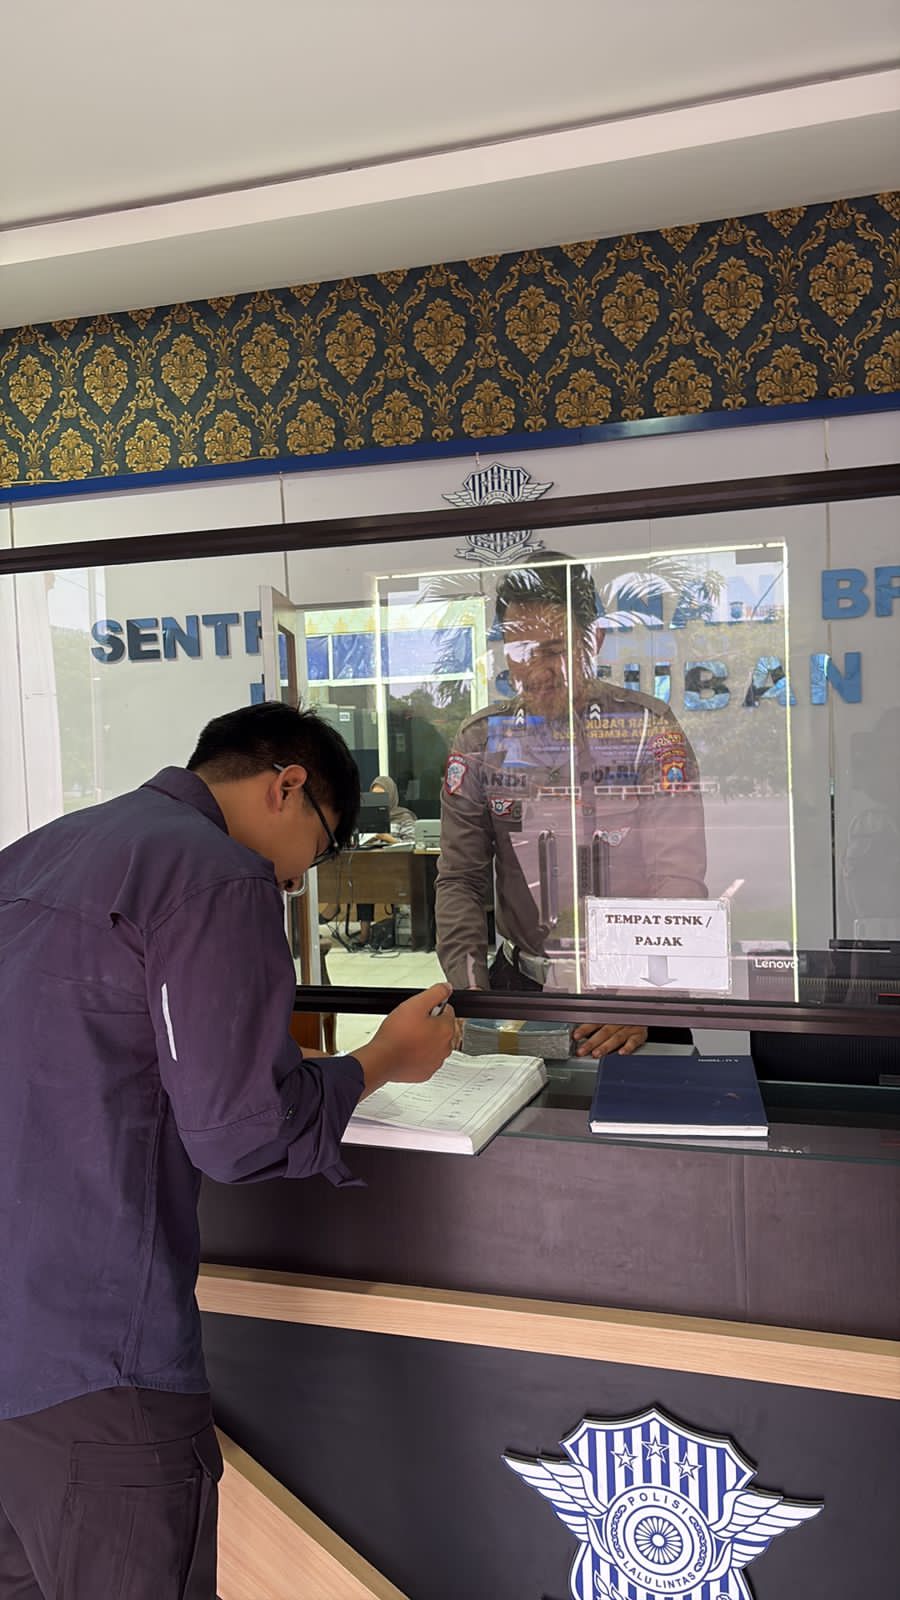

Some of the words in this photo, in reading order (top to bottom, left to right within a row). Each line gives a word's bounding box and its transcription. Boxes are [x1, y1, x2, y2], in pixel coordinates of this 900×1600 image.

[597, 652, 862, 711] UBAN
[605, 914, 661, 925] TEMPAT
[664, 915, 703, 926] STNK
[635, 936, 683, 947] PAJAK
[627, 1491, 688, 1516] POLISI
[623, 1560, 652, 1585] LALU
[655, 1571, 696, 1589] LINTAS
